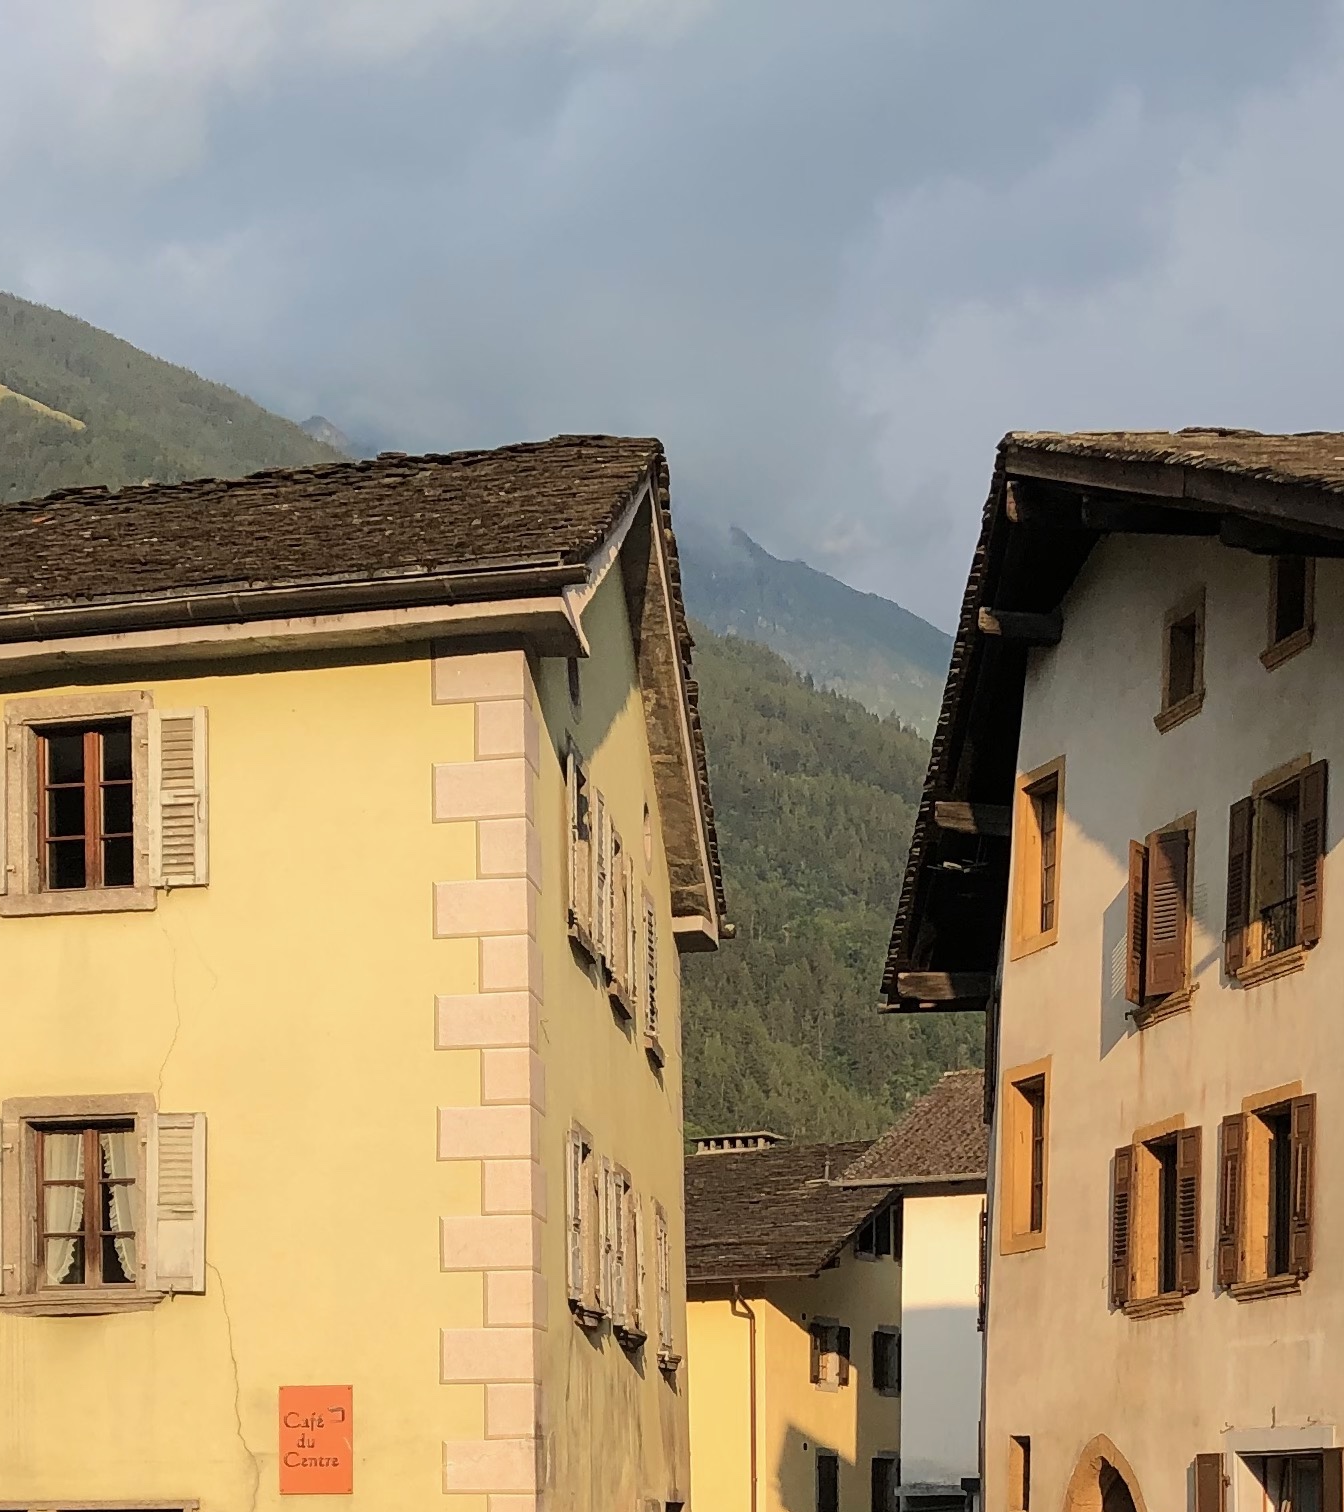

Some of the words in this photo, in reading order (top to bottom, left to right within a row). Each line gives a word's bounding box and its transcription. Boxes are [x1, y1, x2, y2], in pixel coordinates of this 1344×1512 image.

[283, 1411, 325, 1431] Café
[296, 1433, 315, 1448] du
[283, 1451, 340, 1468] Centre
